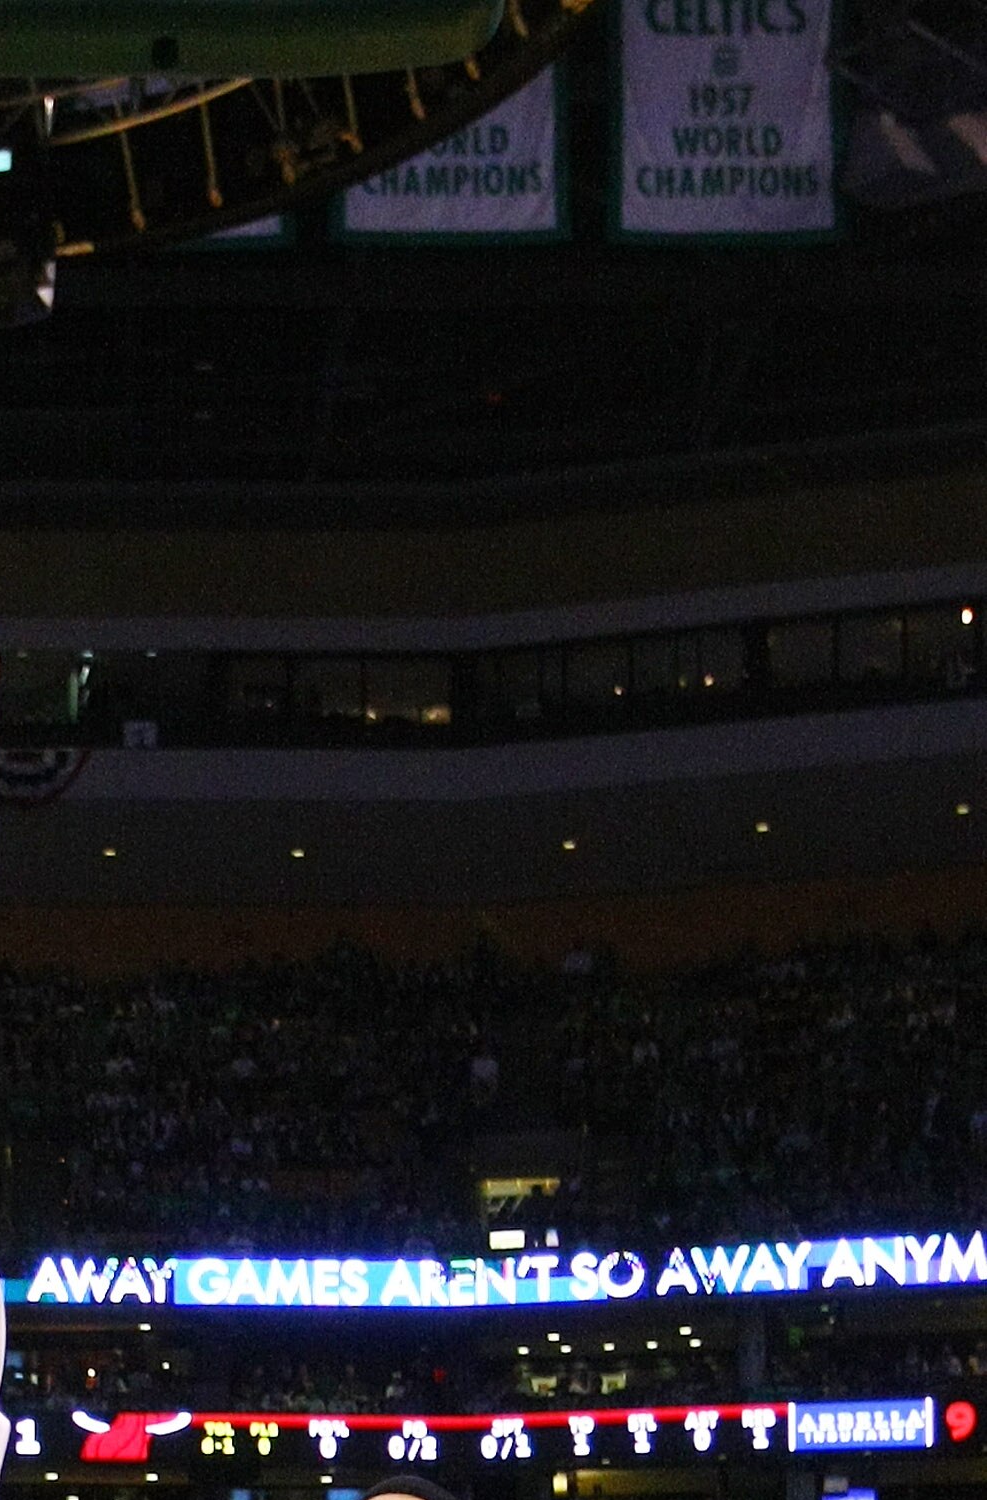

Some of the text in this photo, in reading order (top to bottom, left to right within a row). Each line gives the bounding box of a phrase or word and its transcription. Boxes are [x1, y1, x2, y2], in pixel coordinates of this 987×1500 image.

[645, 0, 807, 36] CELTICS
[671, 124, 783, 158] WORLD
[636, 164, 818, 198] CHAMPIONS
[26, 1256, 178, 1303] AWAY
[187, 1257, 369, 1306] GAMES
[380, 1255, 559, 1306] AREN'T
[570, 1251, 645, 1301] SO
[656, 1241, 812, 1296] AWAY
[15, 1419, 41, 1454] 1
[945, 1401, 976, 1441] 9
